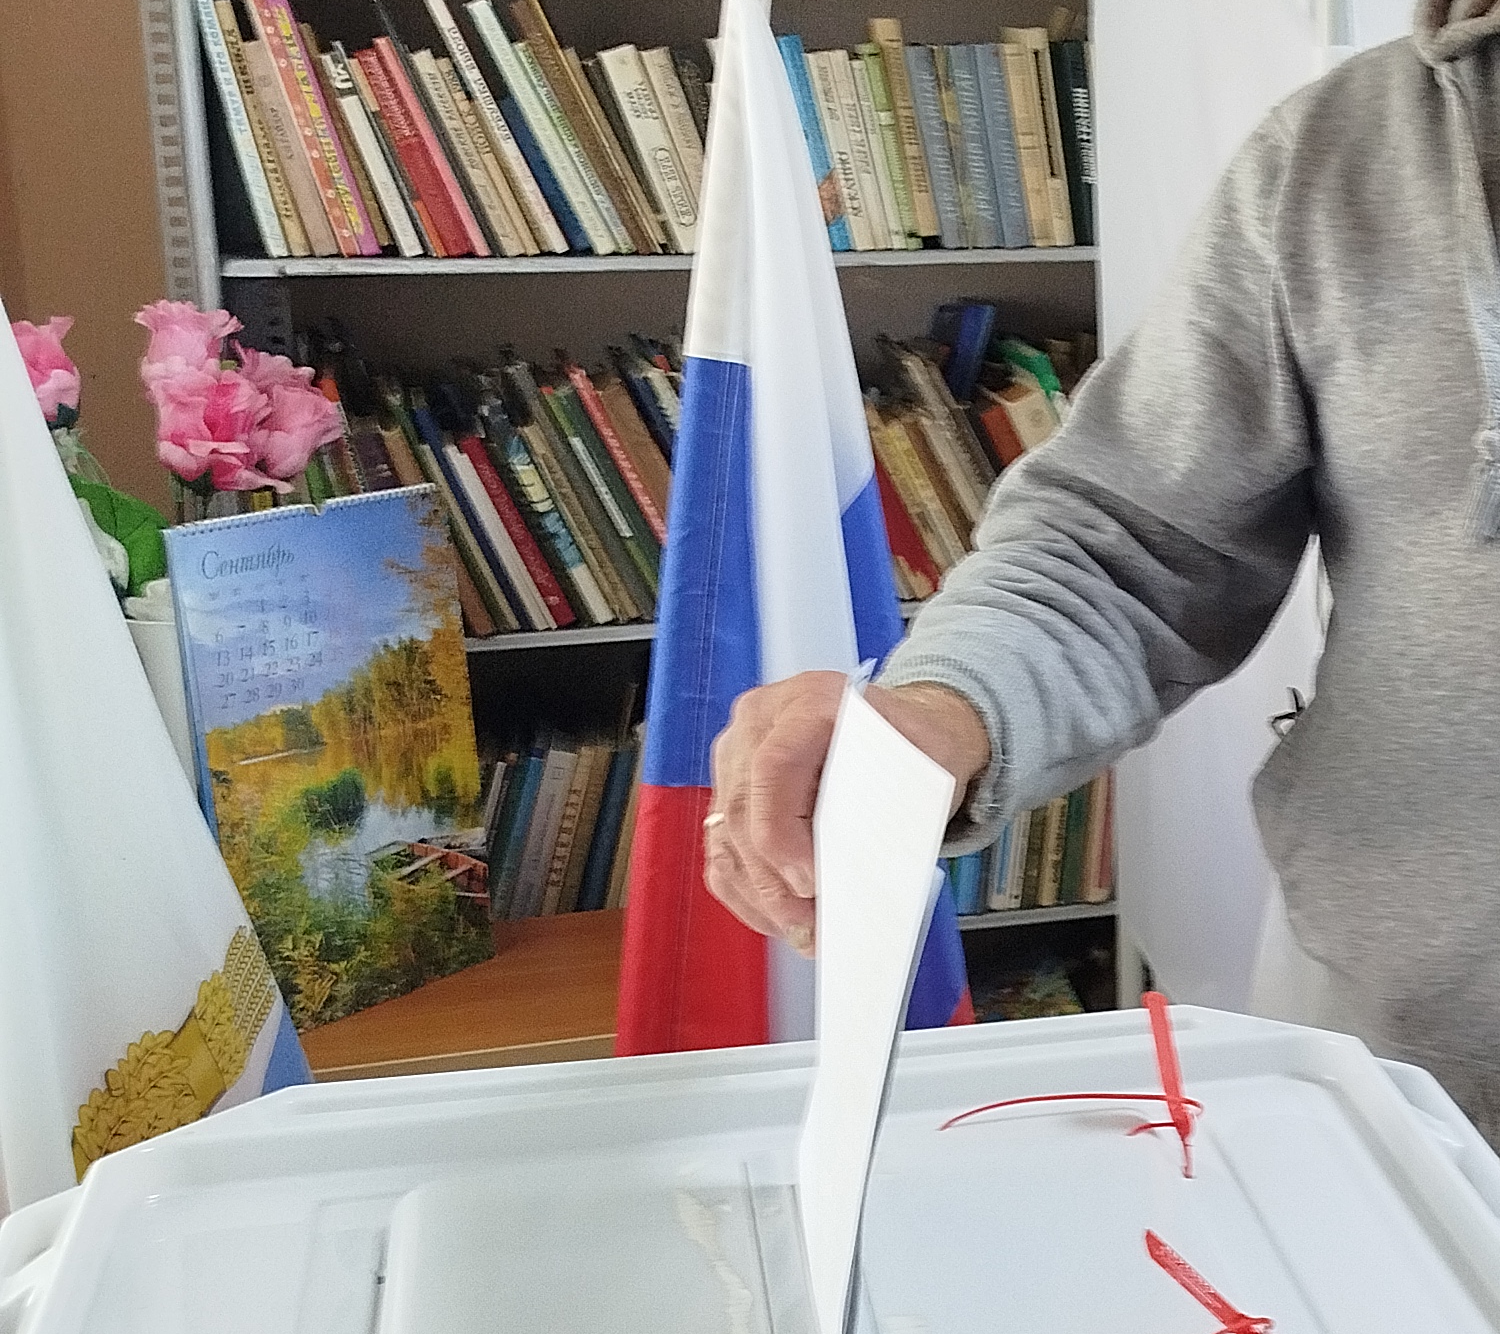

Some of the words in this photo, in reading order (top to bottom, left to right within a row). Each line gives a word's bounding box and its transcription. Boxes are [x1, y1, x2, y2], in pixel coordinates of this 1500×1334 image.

[201, 542, 295, 580] Сентябрь
[217, 650, 230, 667] 13
[240, 647, 253, 661] 14
[262, 639, 276, 656] 15
[284, 633, 298, 651] 16
